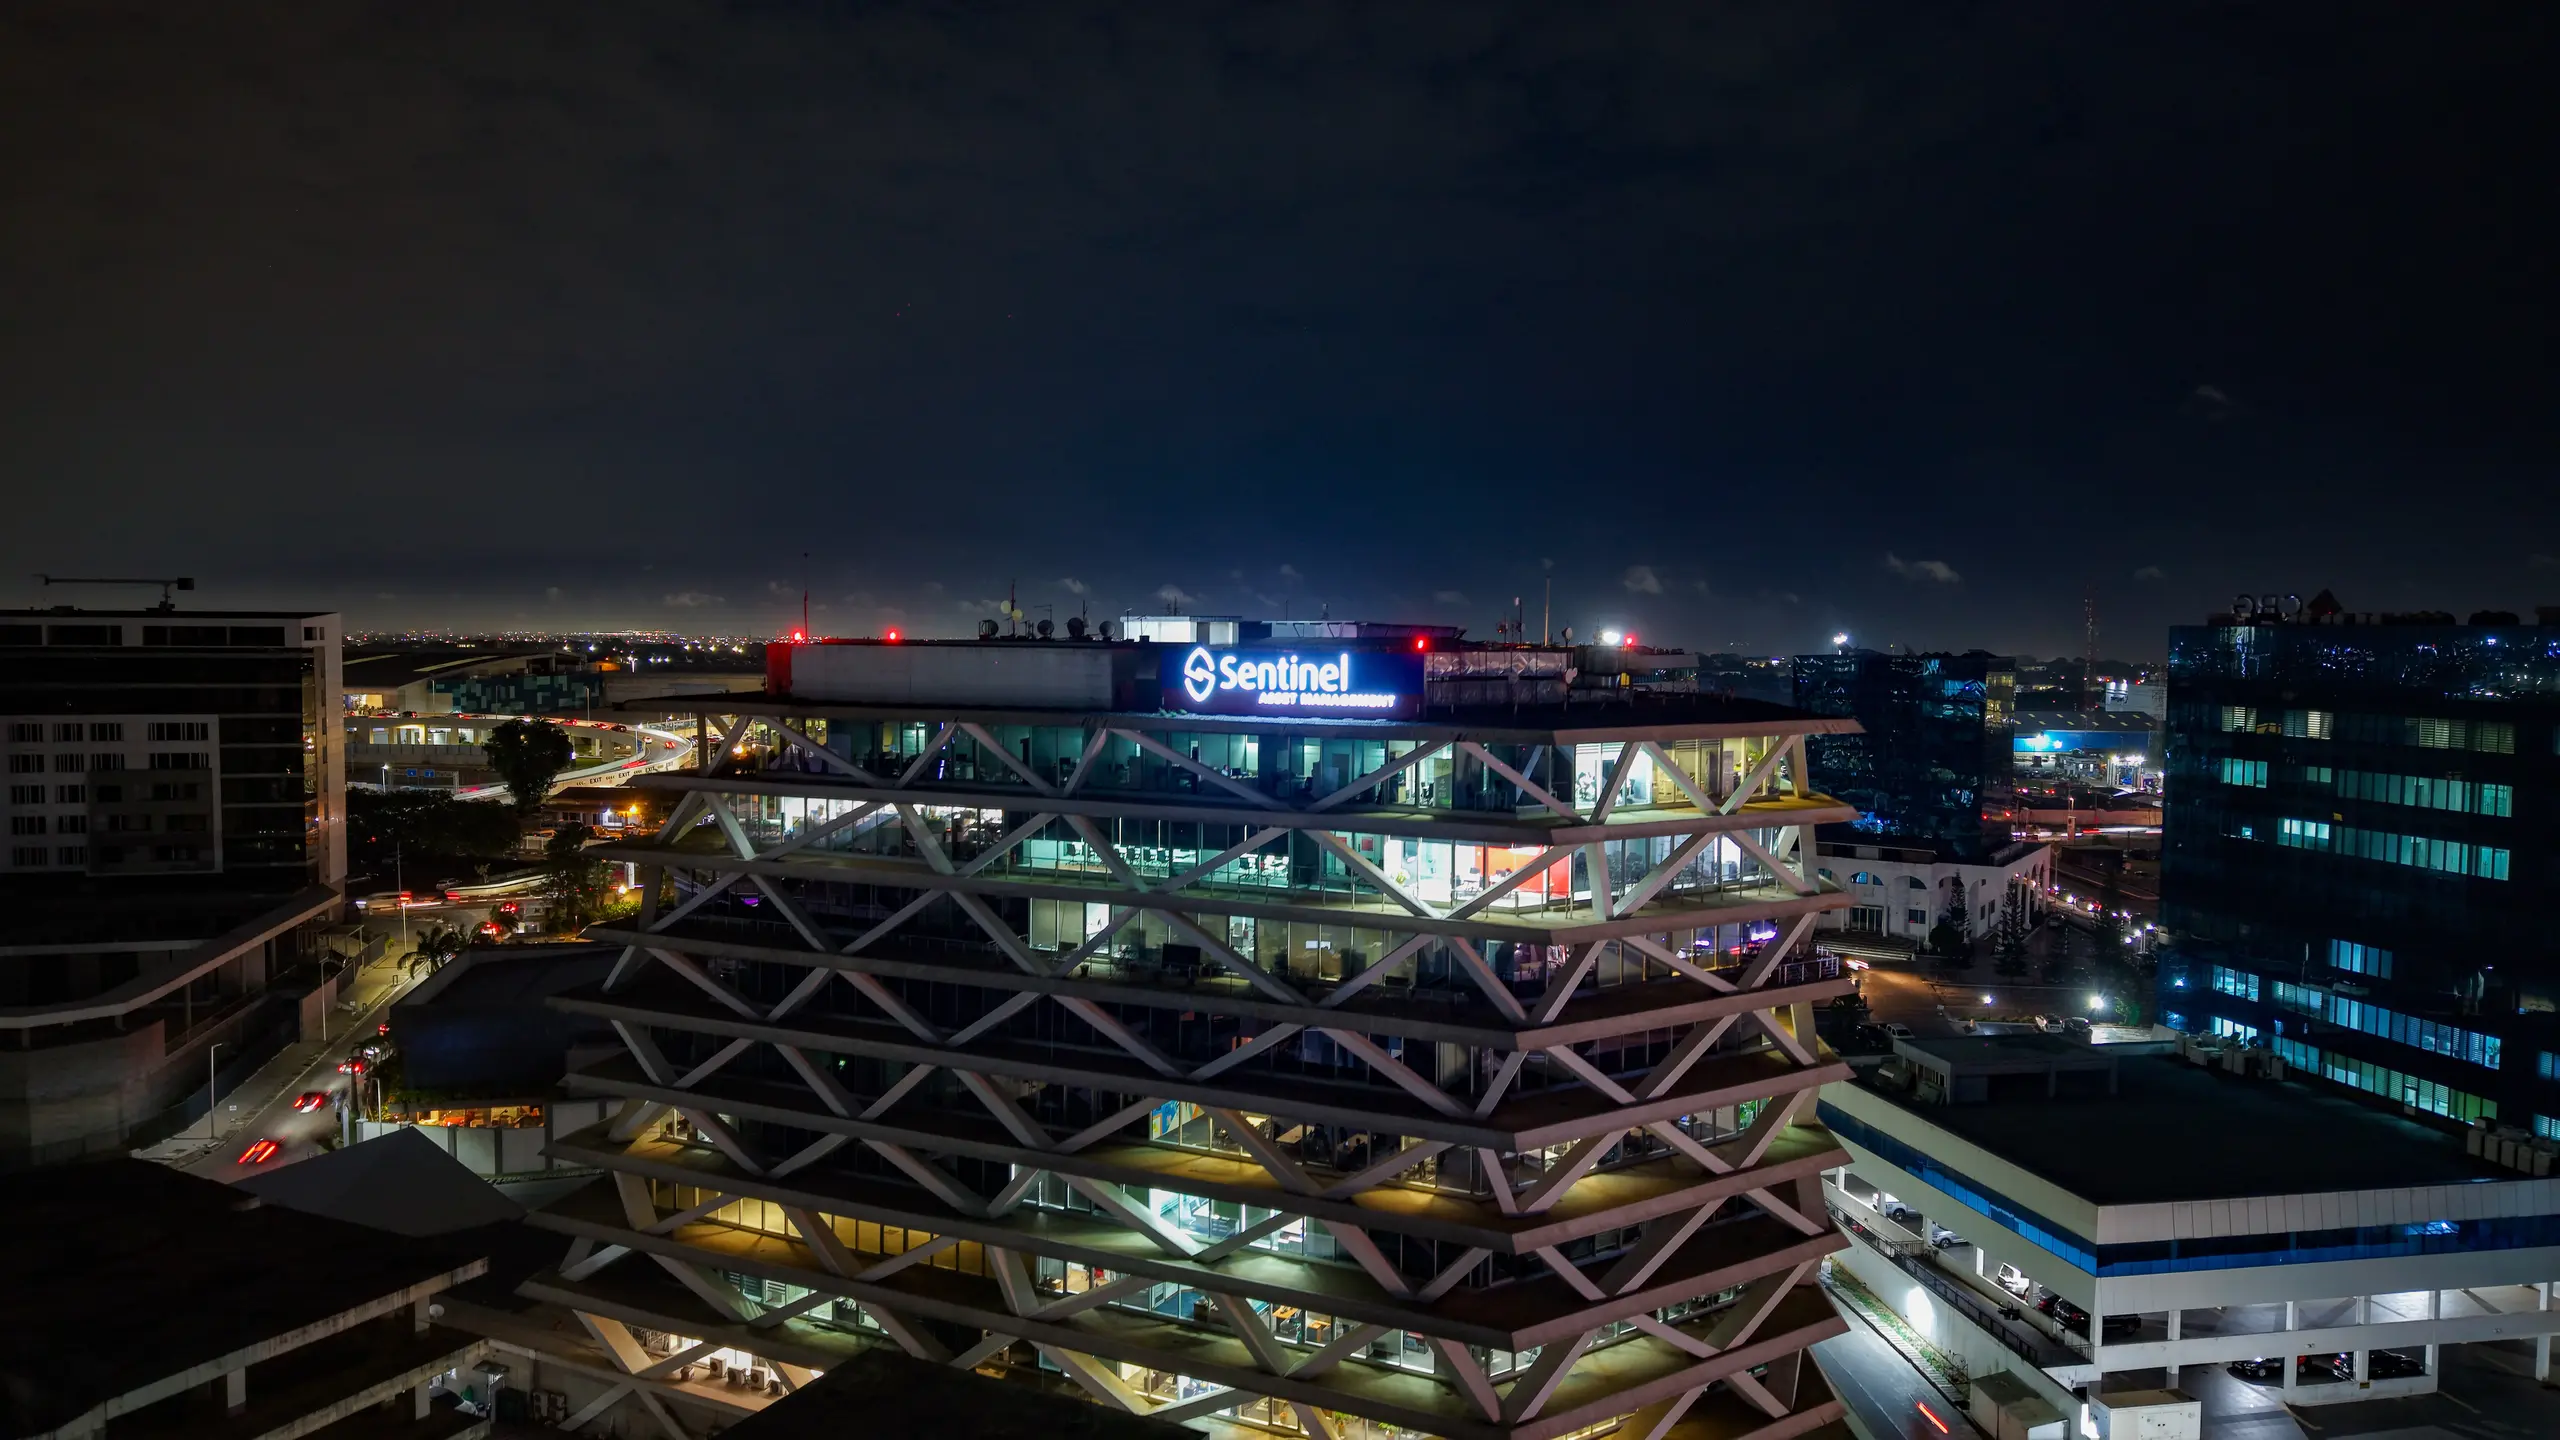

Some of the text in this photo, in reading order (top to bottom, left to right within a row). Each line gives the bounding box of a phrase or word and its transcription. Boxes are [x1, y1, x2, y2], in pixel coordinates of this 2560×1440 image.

[1219, 653, 1349, 692] Sentinel
[1258, 692, 1396, 708] ASSET MANAGEMENT
